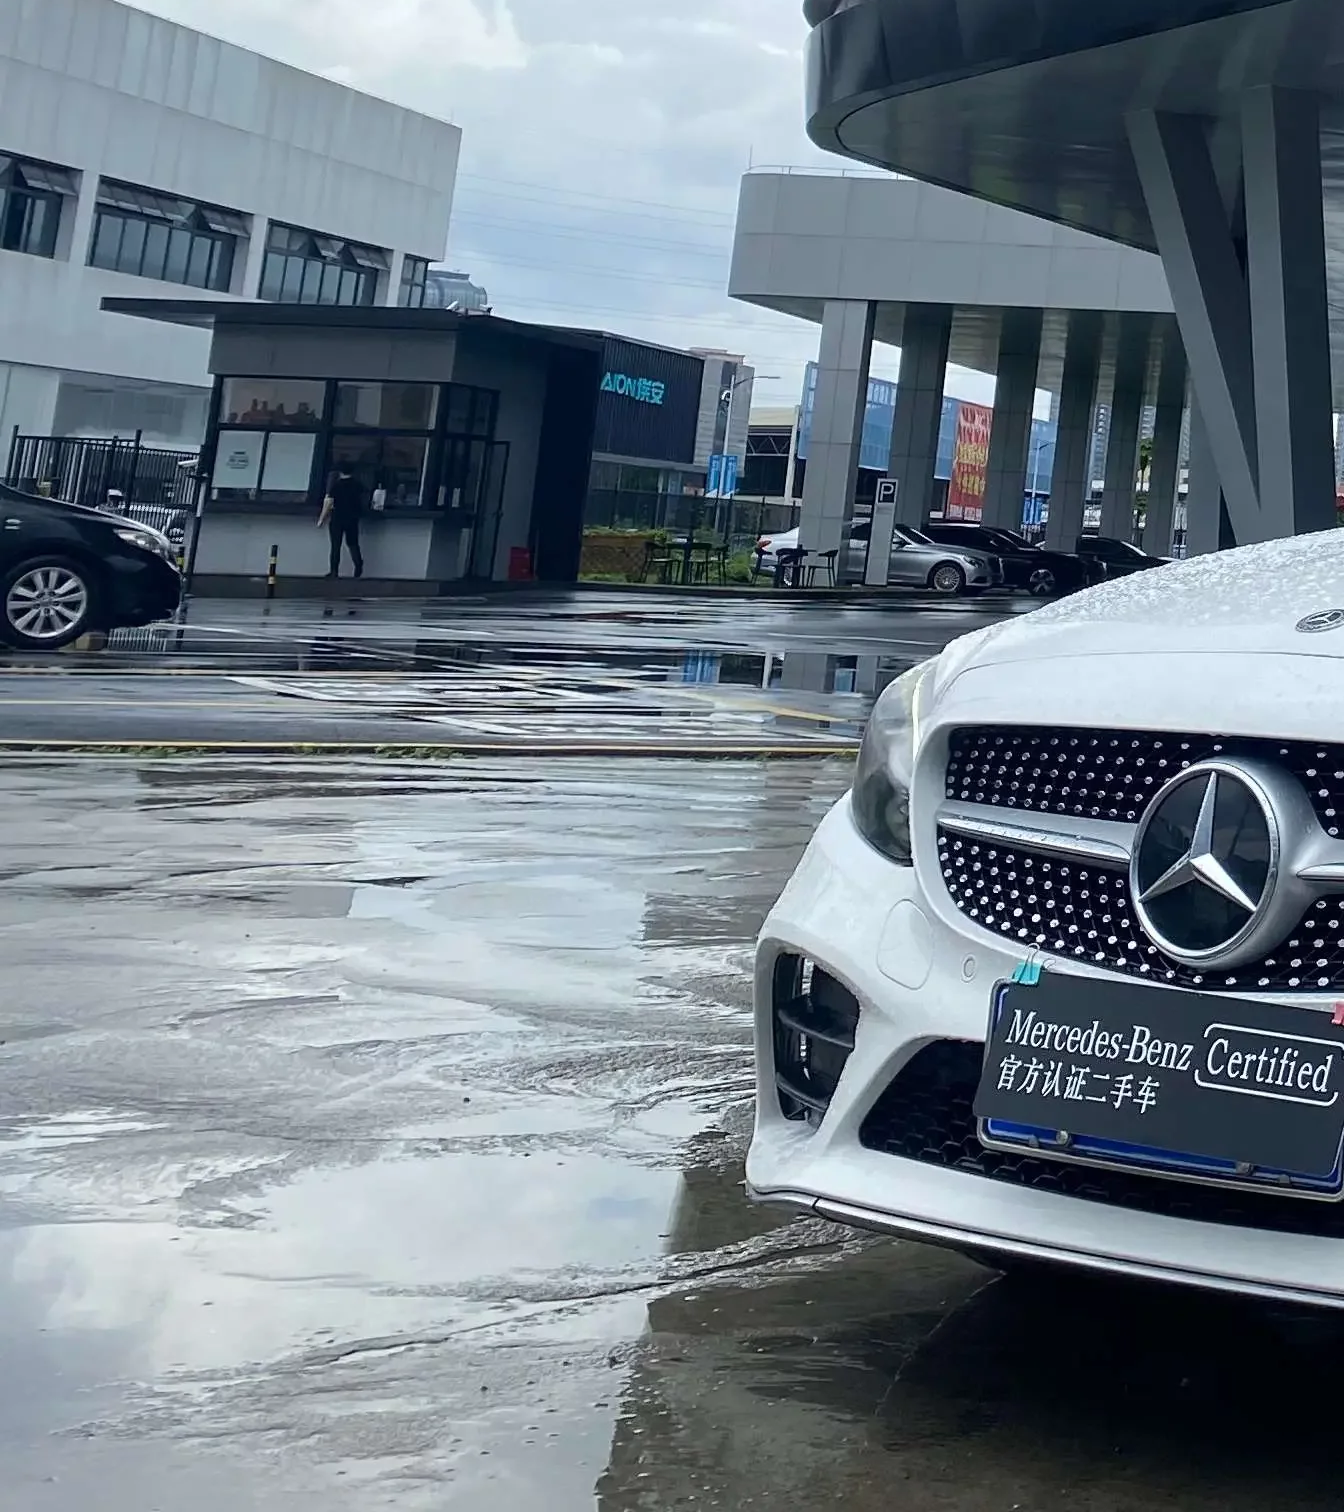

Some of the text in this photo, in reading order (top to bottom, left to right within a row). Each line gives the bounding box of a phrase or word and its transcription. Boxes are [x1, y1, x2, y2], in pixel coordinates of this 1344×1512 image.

[880, 483, 894, 501] P
[1005, 1009, 1333, 1093] Mercedes-Benz Certified
[997, 1054, 1160, 1114] 官方认证二手车
